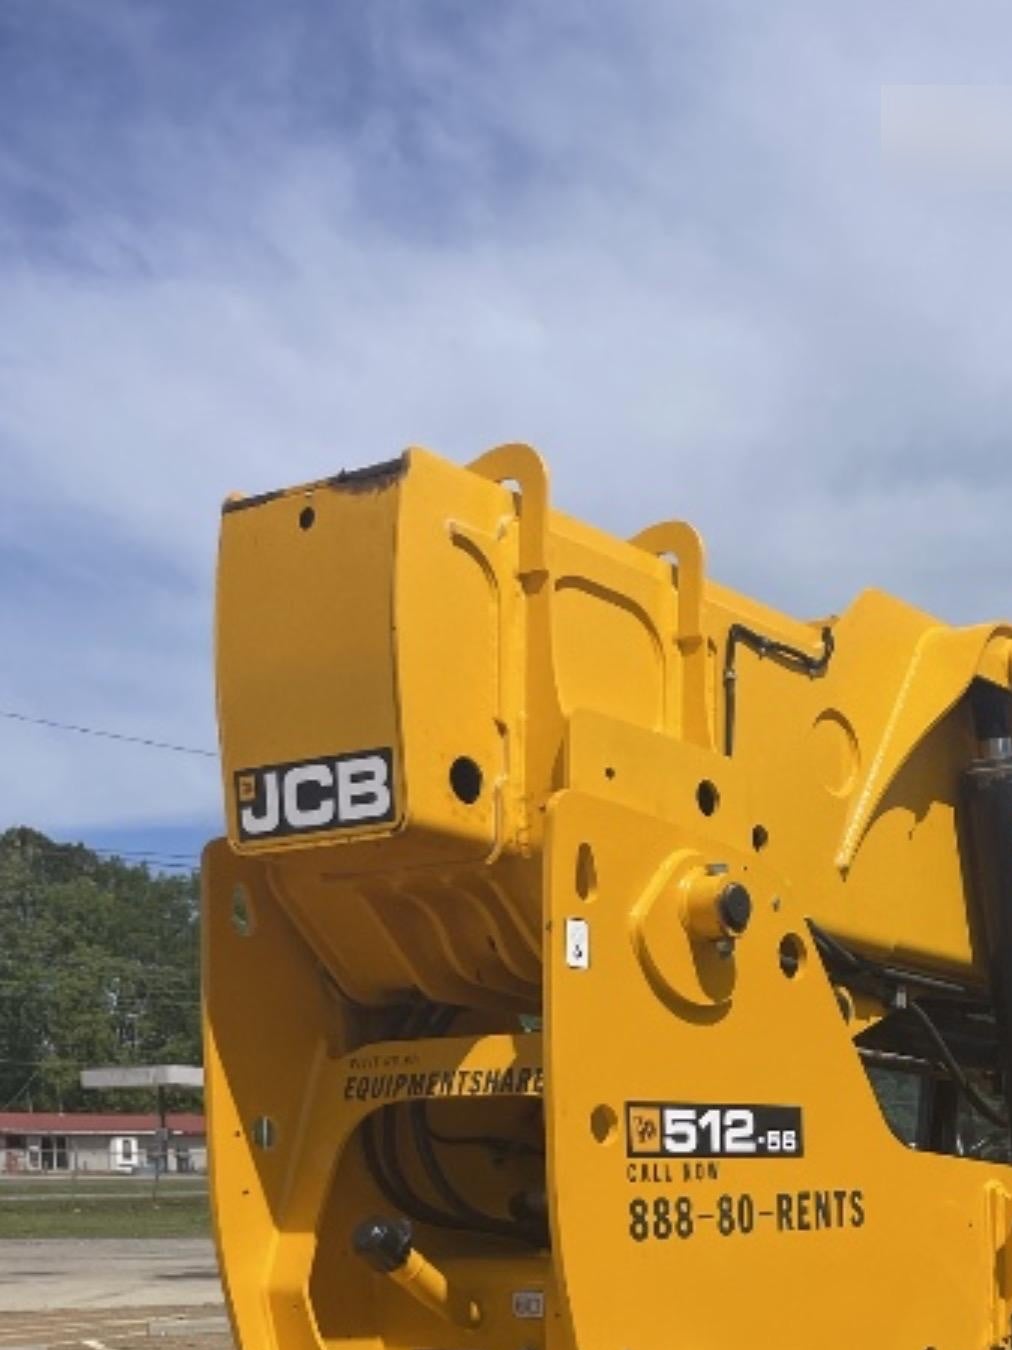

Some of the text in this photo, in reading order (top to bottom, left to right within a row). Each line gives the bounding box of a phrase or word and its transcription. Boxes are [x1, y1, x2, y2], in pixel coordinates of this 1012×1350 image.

[241, 755, 390, 835] JCB
[627, 1163, 672, 1183] CALL
[629, 1190, 865, 1242] 888-80-RENTS
